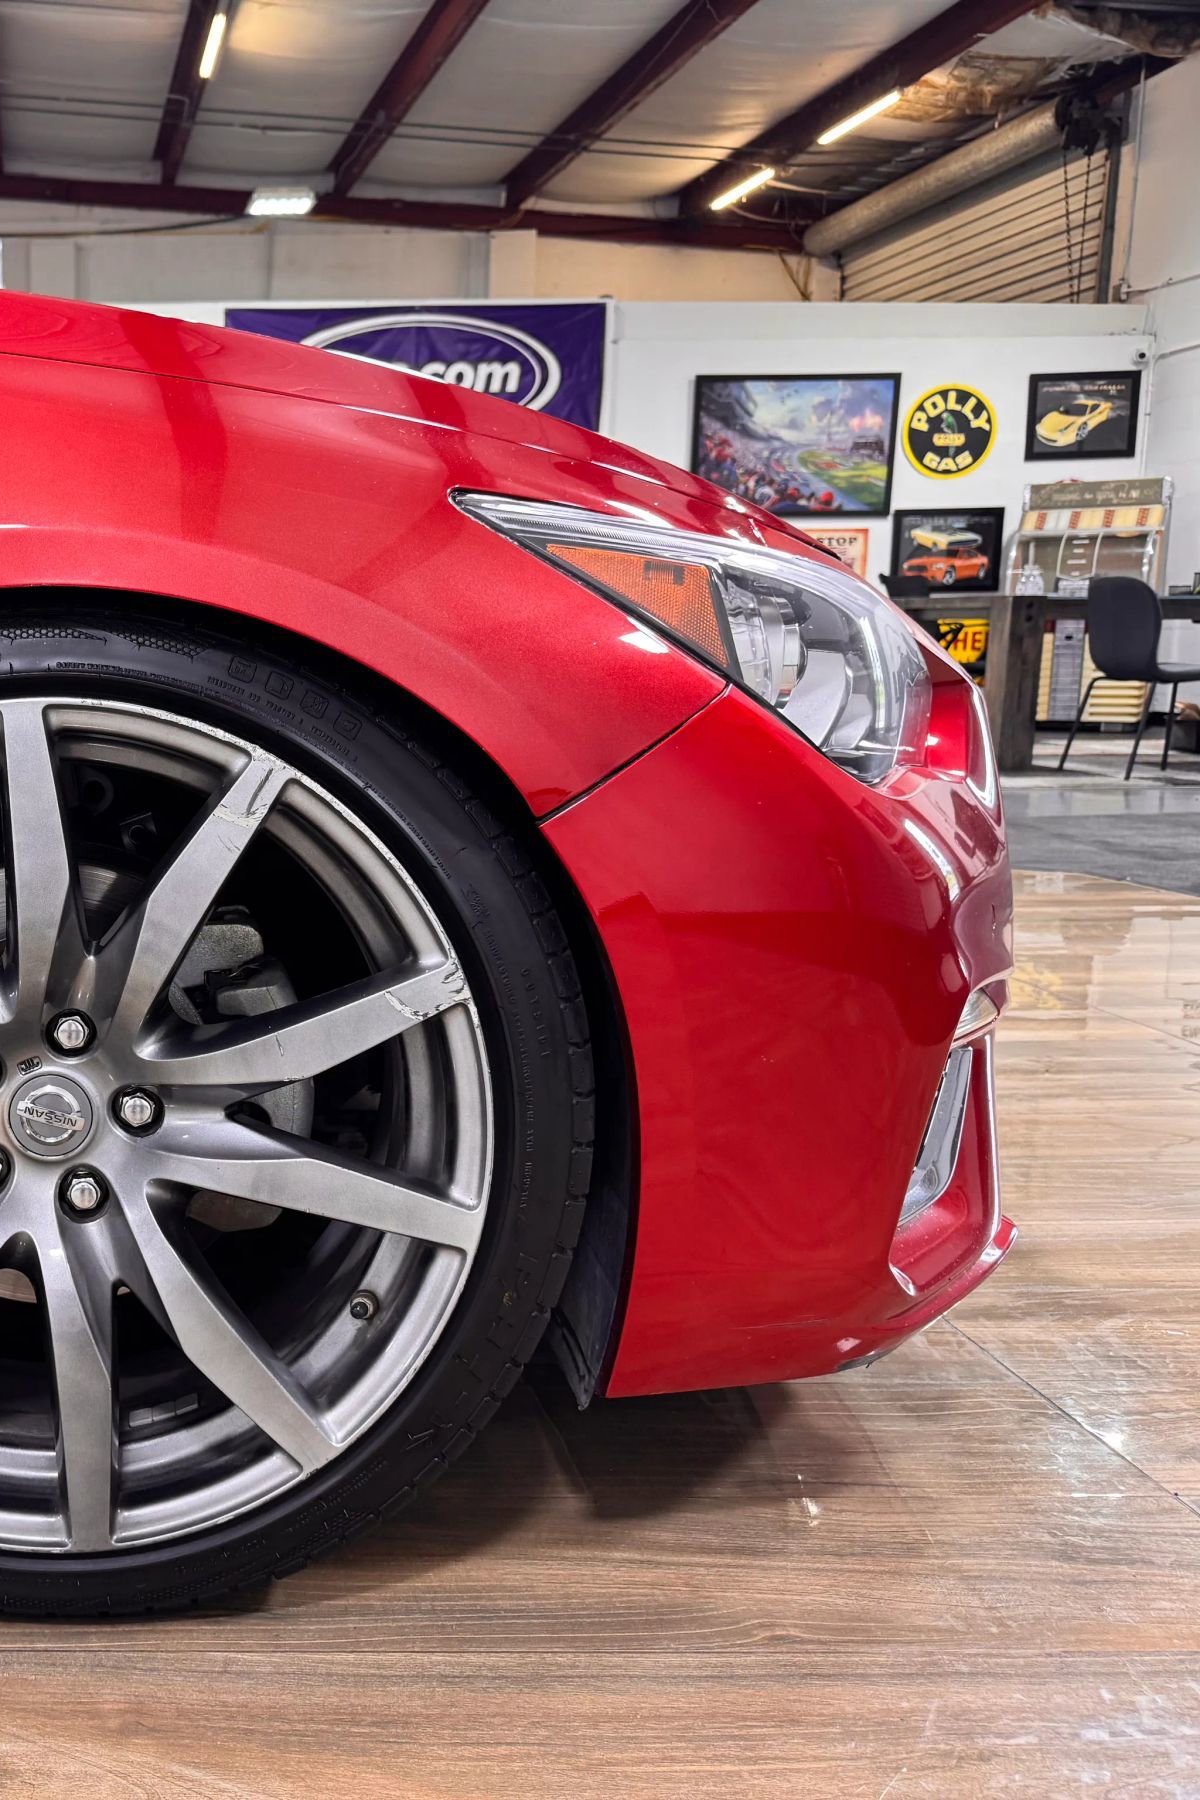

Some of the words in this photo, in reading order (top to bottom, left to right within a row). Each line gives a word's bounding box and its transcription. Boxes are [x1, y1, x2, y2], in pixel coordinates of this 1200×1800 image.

[910, 390, 990, 432] POLLY
[923, 450, 973, 472] GAS
[23, 1105, 77, 1127] NISSAN
